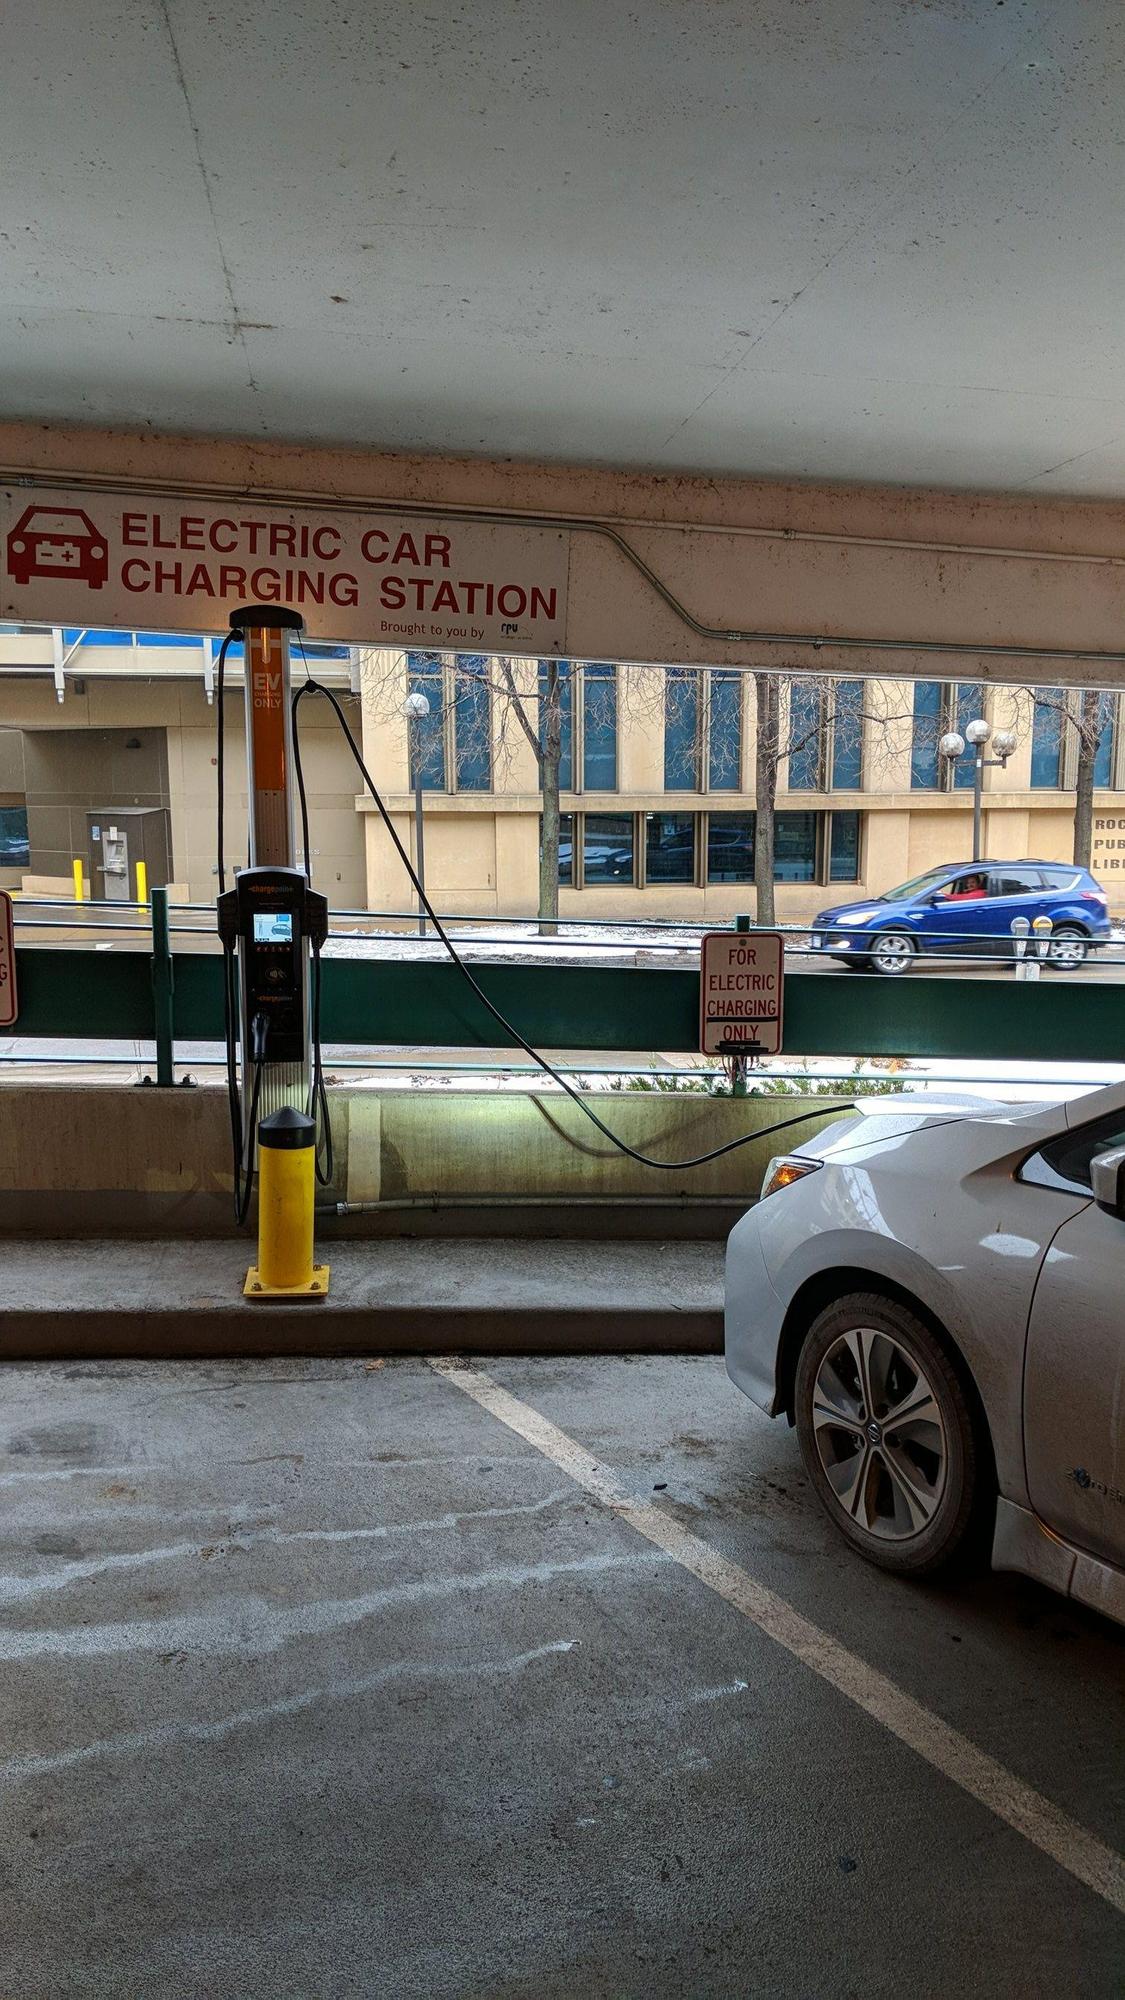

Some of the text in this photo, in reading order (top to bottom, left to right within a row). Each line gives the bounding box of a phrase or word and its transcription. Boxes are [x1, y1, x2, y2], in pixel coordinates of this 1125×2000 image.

[122, 512, 452, 568] ELECTRIC CAR
[121, 558, 557, 620] CHARGING STATION
[380, 620, 485, 640] Brought to you by
[500, 623, 519, 635] rpu
[254, 672, 281, 690] EV
[254, 698, 282, 708] ONLY
[728, 949, 757, 966] FOR
[709, 974, 775, 991] ELECTRIC
[707, 1000, 776, 1016] CHARGING
[723, 1025, 759, 1041] ONLY
